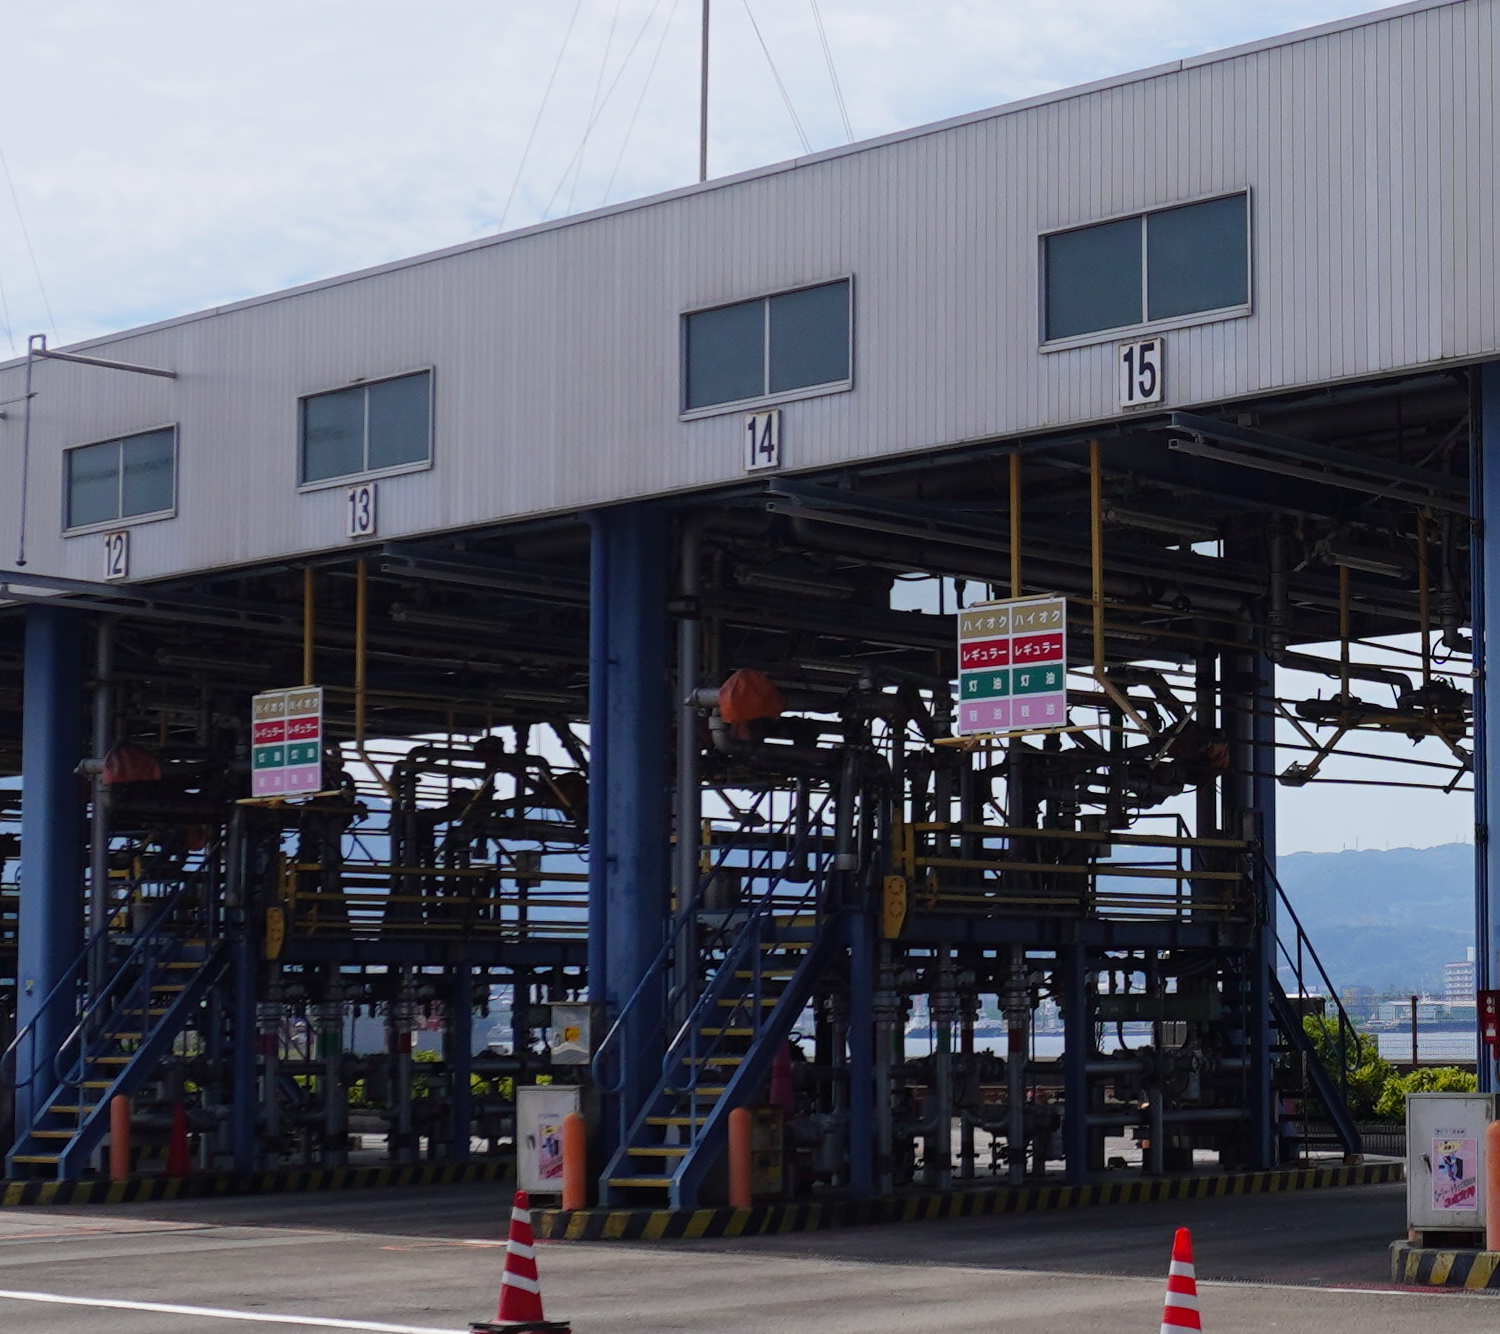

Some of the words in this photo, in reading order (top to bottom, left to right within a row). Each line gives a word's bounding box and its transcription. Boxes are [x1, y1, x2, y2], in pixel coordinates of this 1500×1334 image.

[1123, 342, 1156, 401] 15
[748, 414, 775, 466] 14
[349, 488, 369, 534] 13
[105, 535, 123, 576] 12
[963, 616, 1007, 632] ハイオク
[1015, 609, 1061, 625] ハイオク
[963, 648, 1007, 661] レギュラー
[1015, 642, 1061, 656] レギュラー
